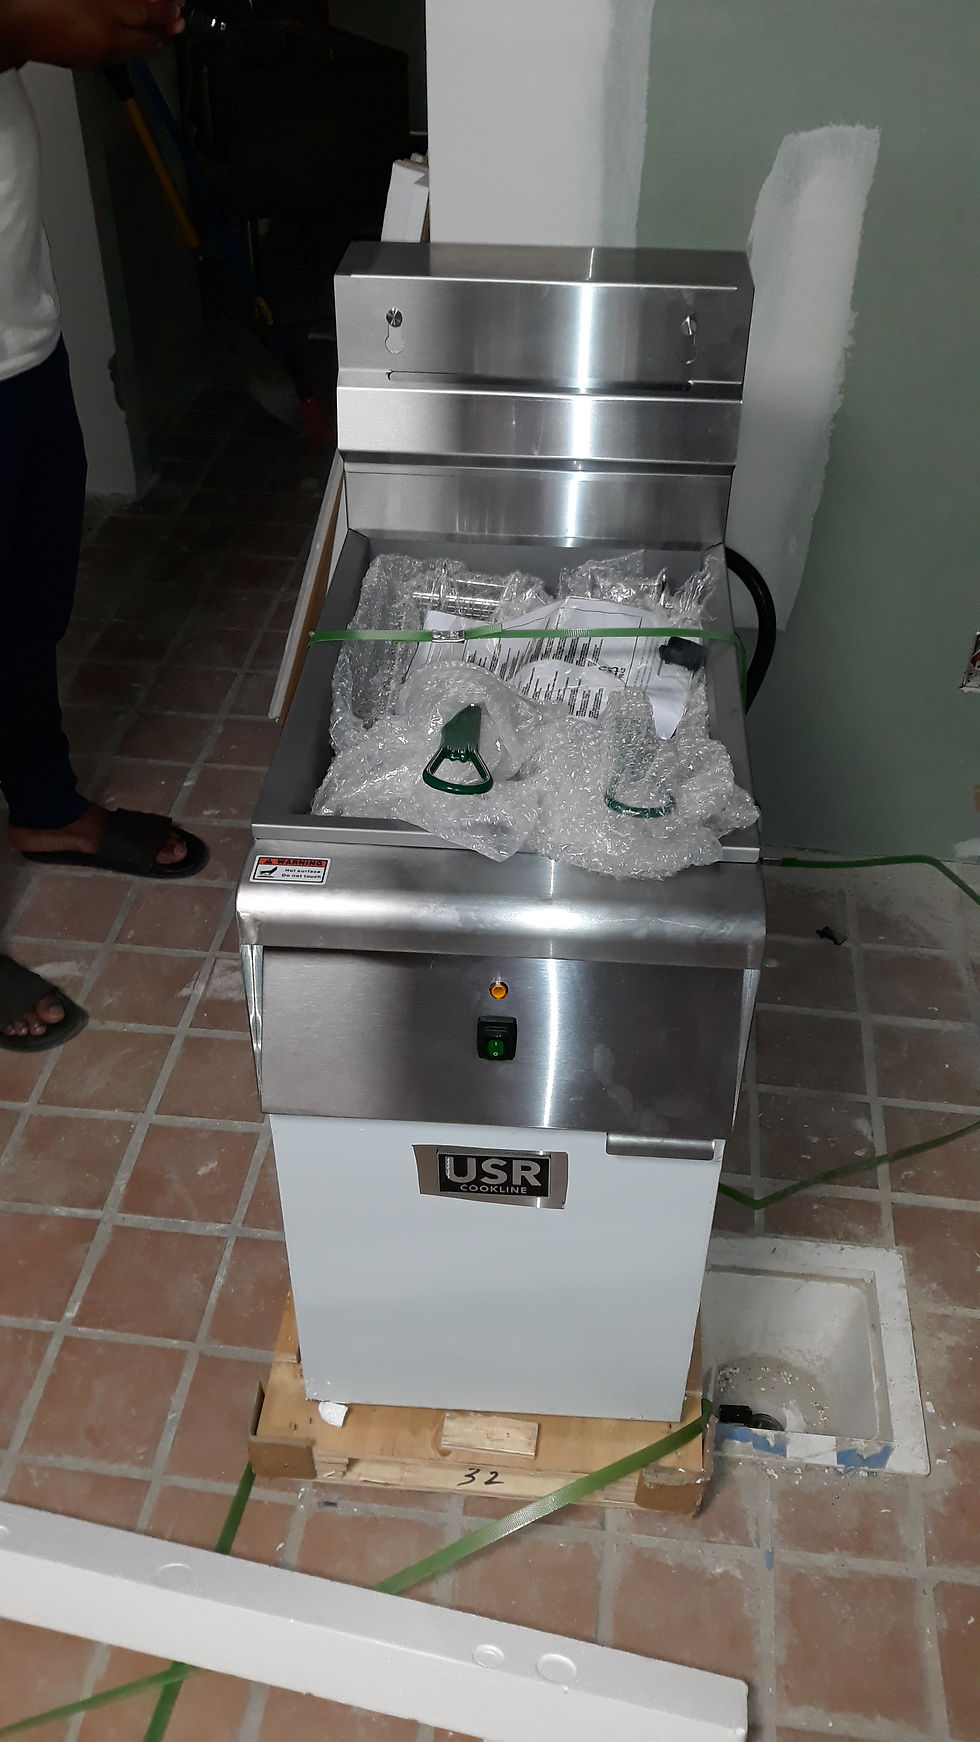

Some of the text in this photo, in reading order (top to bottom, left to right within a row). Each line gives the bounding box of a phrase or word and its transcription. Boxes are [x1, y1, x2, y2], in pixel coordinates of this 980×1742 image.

[277, 858, 323, 867] WARNING
[445, 1156, 542, 1186] USR
[460, 1185, 527, 1194] COOKLINE
[457, 1468, 504, 1486] 32
